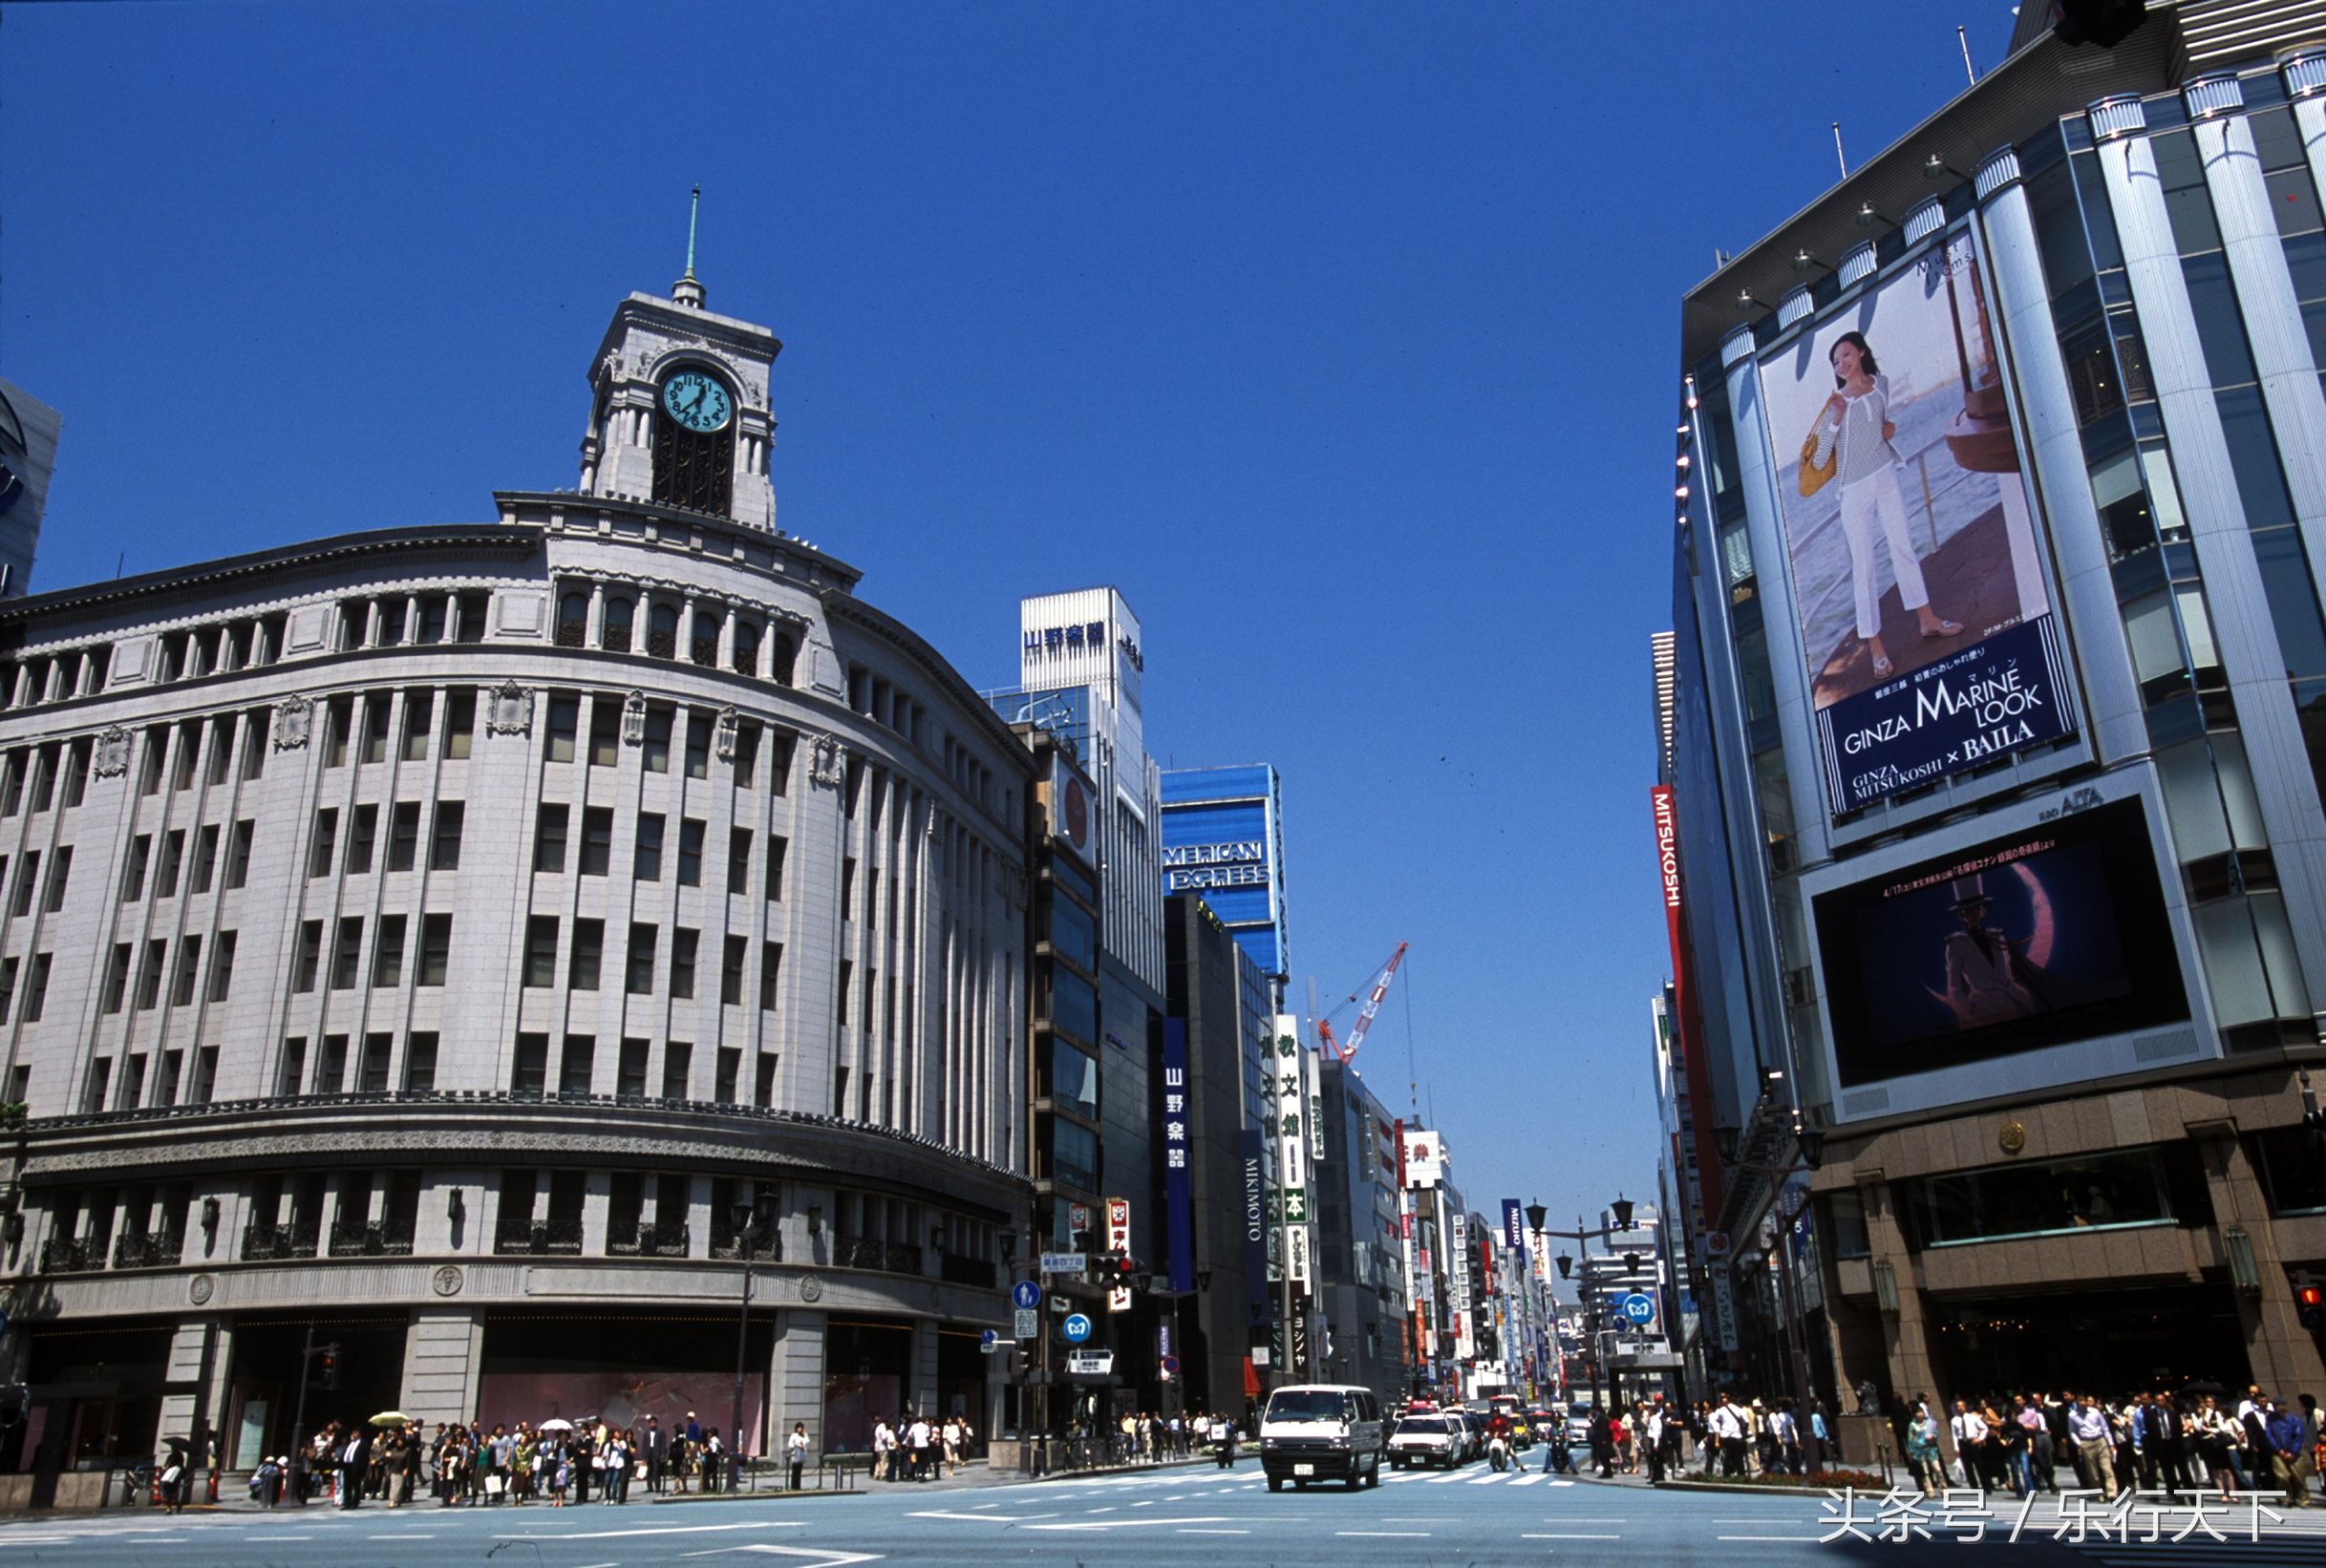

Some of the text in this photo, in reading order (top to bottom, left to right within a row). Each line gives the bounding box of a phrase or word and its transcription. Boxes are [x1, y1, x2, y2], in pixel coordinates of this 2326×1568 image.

[1968, 657, 2017, 683] マリン
[1844, 667, 2022, 754] GINZA MARINE
[1974, 685, 2043, 729] LOOK
[1852, 764, 1899, 790] GINZA
[1854, 758, 1944, 801] MITSUKOSHI
[1962, 719, 2036, 762] BAILA
[1162, 840, 1262, 867] MERICAN
[1654, 794, 1680, 907] MITSUKOSHI
[1170, 863, 1270, 890] EXPRESS
[1277, 1033, 1300, 1138] 教文館
[1165, 1068, 1185, 1168] 山野楽器
[1246, 1158, 1262, 1242] MIKIMOTO
[1286, 1193, 1304, 1218] 本
[1510, 1207, 1521, 1245] MIZUHO
[1294, 1317, 1306, 1367] ヨシノヤ
